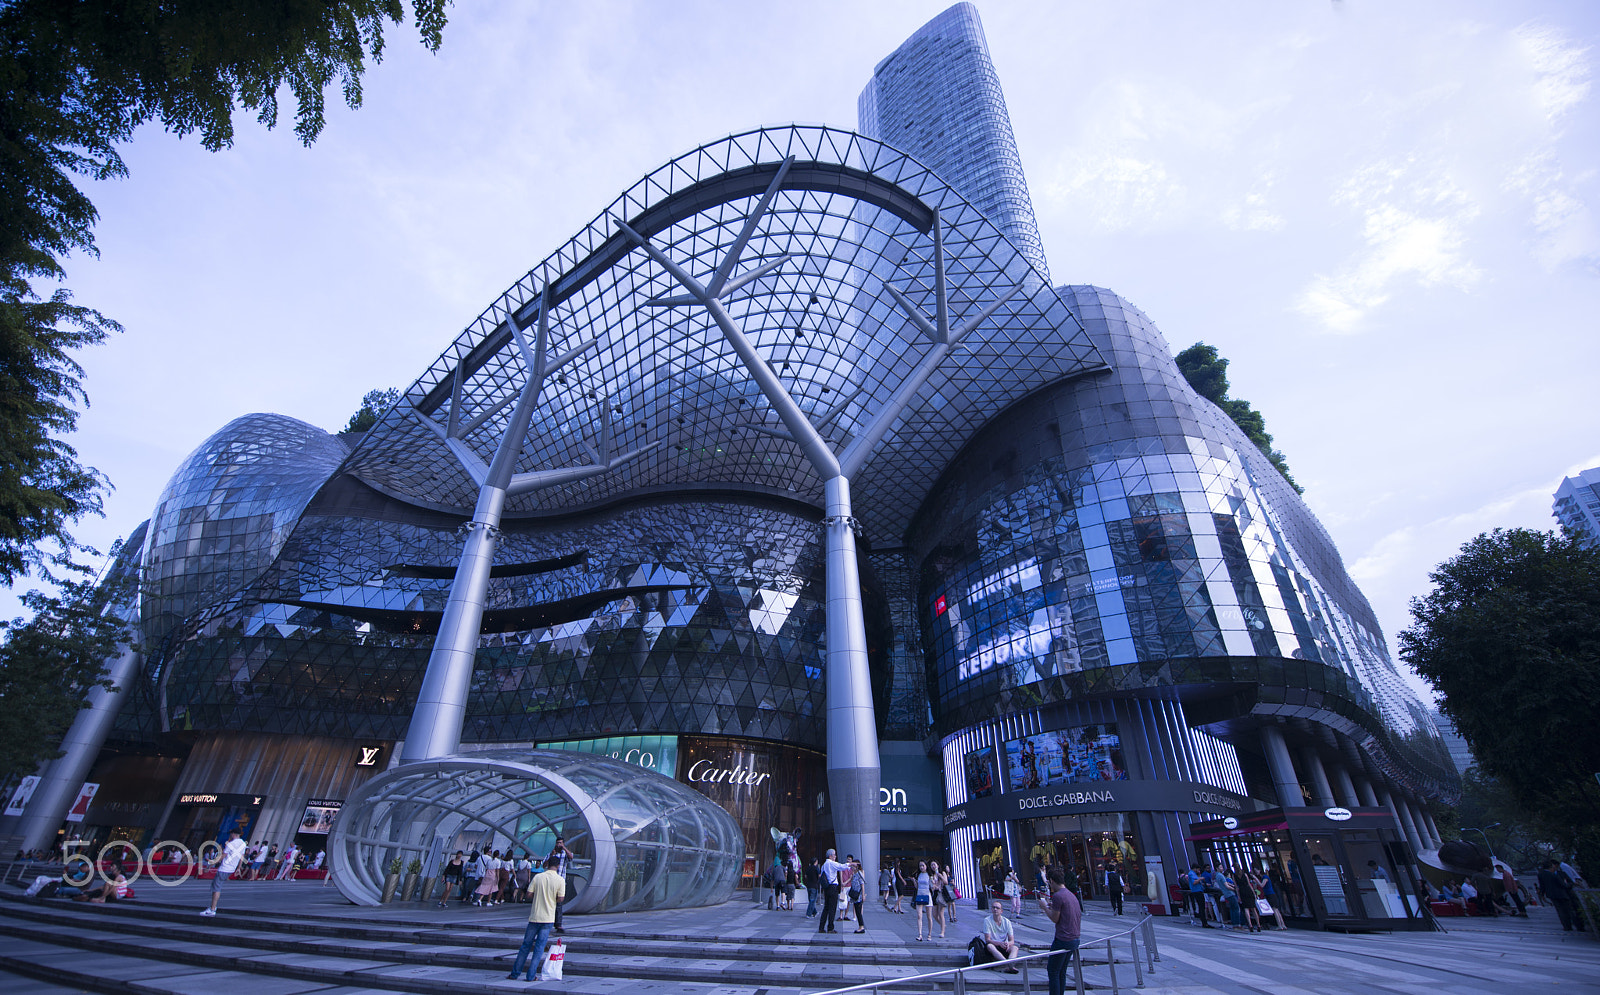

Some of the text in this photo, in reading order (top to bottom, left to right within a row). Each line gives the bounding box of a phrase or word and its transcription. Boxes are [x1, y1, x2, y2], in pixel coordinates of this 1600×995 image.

[688, 759, 770, 786] Cartier
[180, 795, 218, 804] LOUIS VUITTON
[1019, 795, 1048, 810] DOLCE
[1053, 790, 1115, 806] GABBANA
